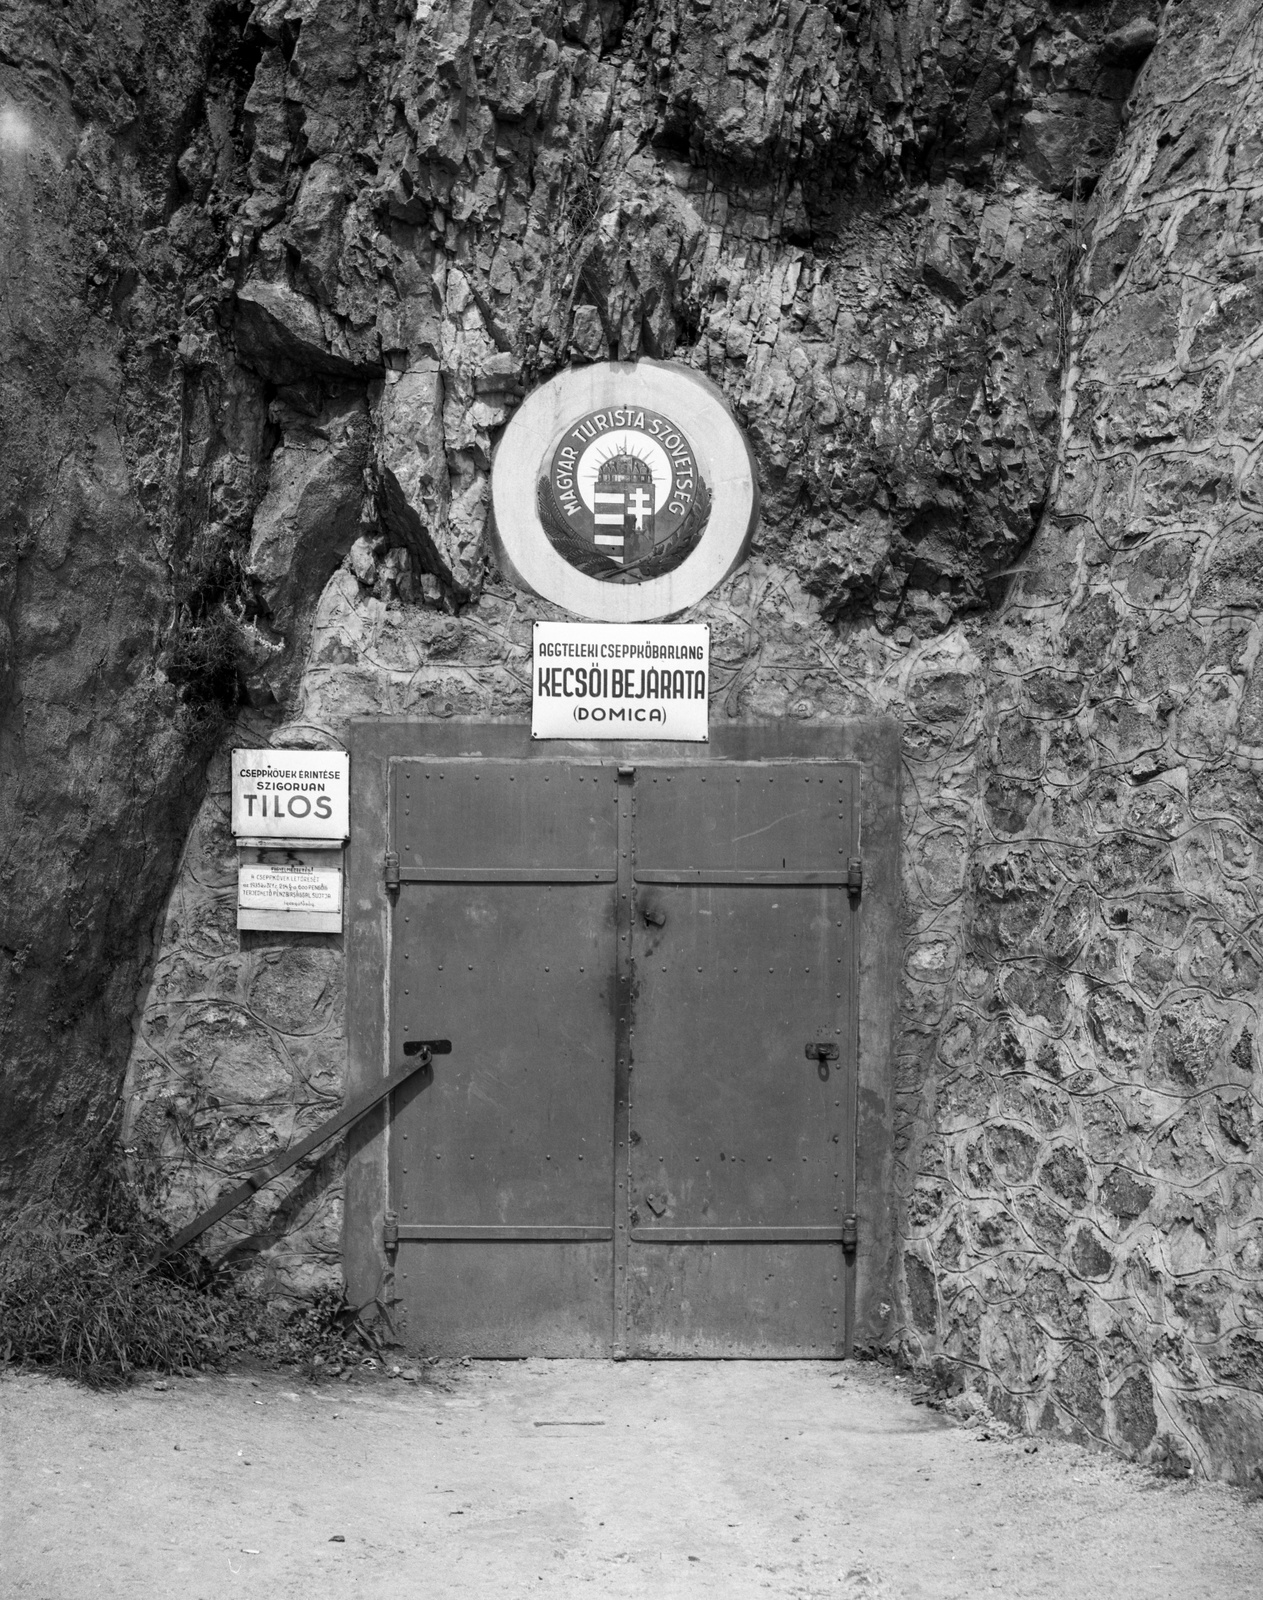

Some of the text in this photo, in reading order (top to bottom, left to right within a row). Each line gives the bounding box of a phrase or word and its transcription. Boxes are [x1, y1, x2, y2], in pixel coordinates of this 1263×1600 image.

[556, 409, 694, 516] MAGYAR TURISTA SZÖVETSÉG
[539, 642, 598, 657] AGGTELEKI
[612, 666, 706, 700] BEJÁRATA
[573, 705, 667, 726] (DOMICA)
[239, 767, 341, 780] CSEPPKÖVEK ÉRINTÉSE
[256, 781, 325, 792] SZIGORUAN
[243, 794, 333, 820] TILOS
